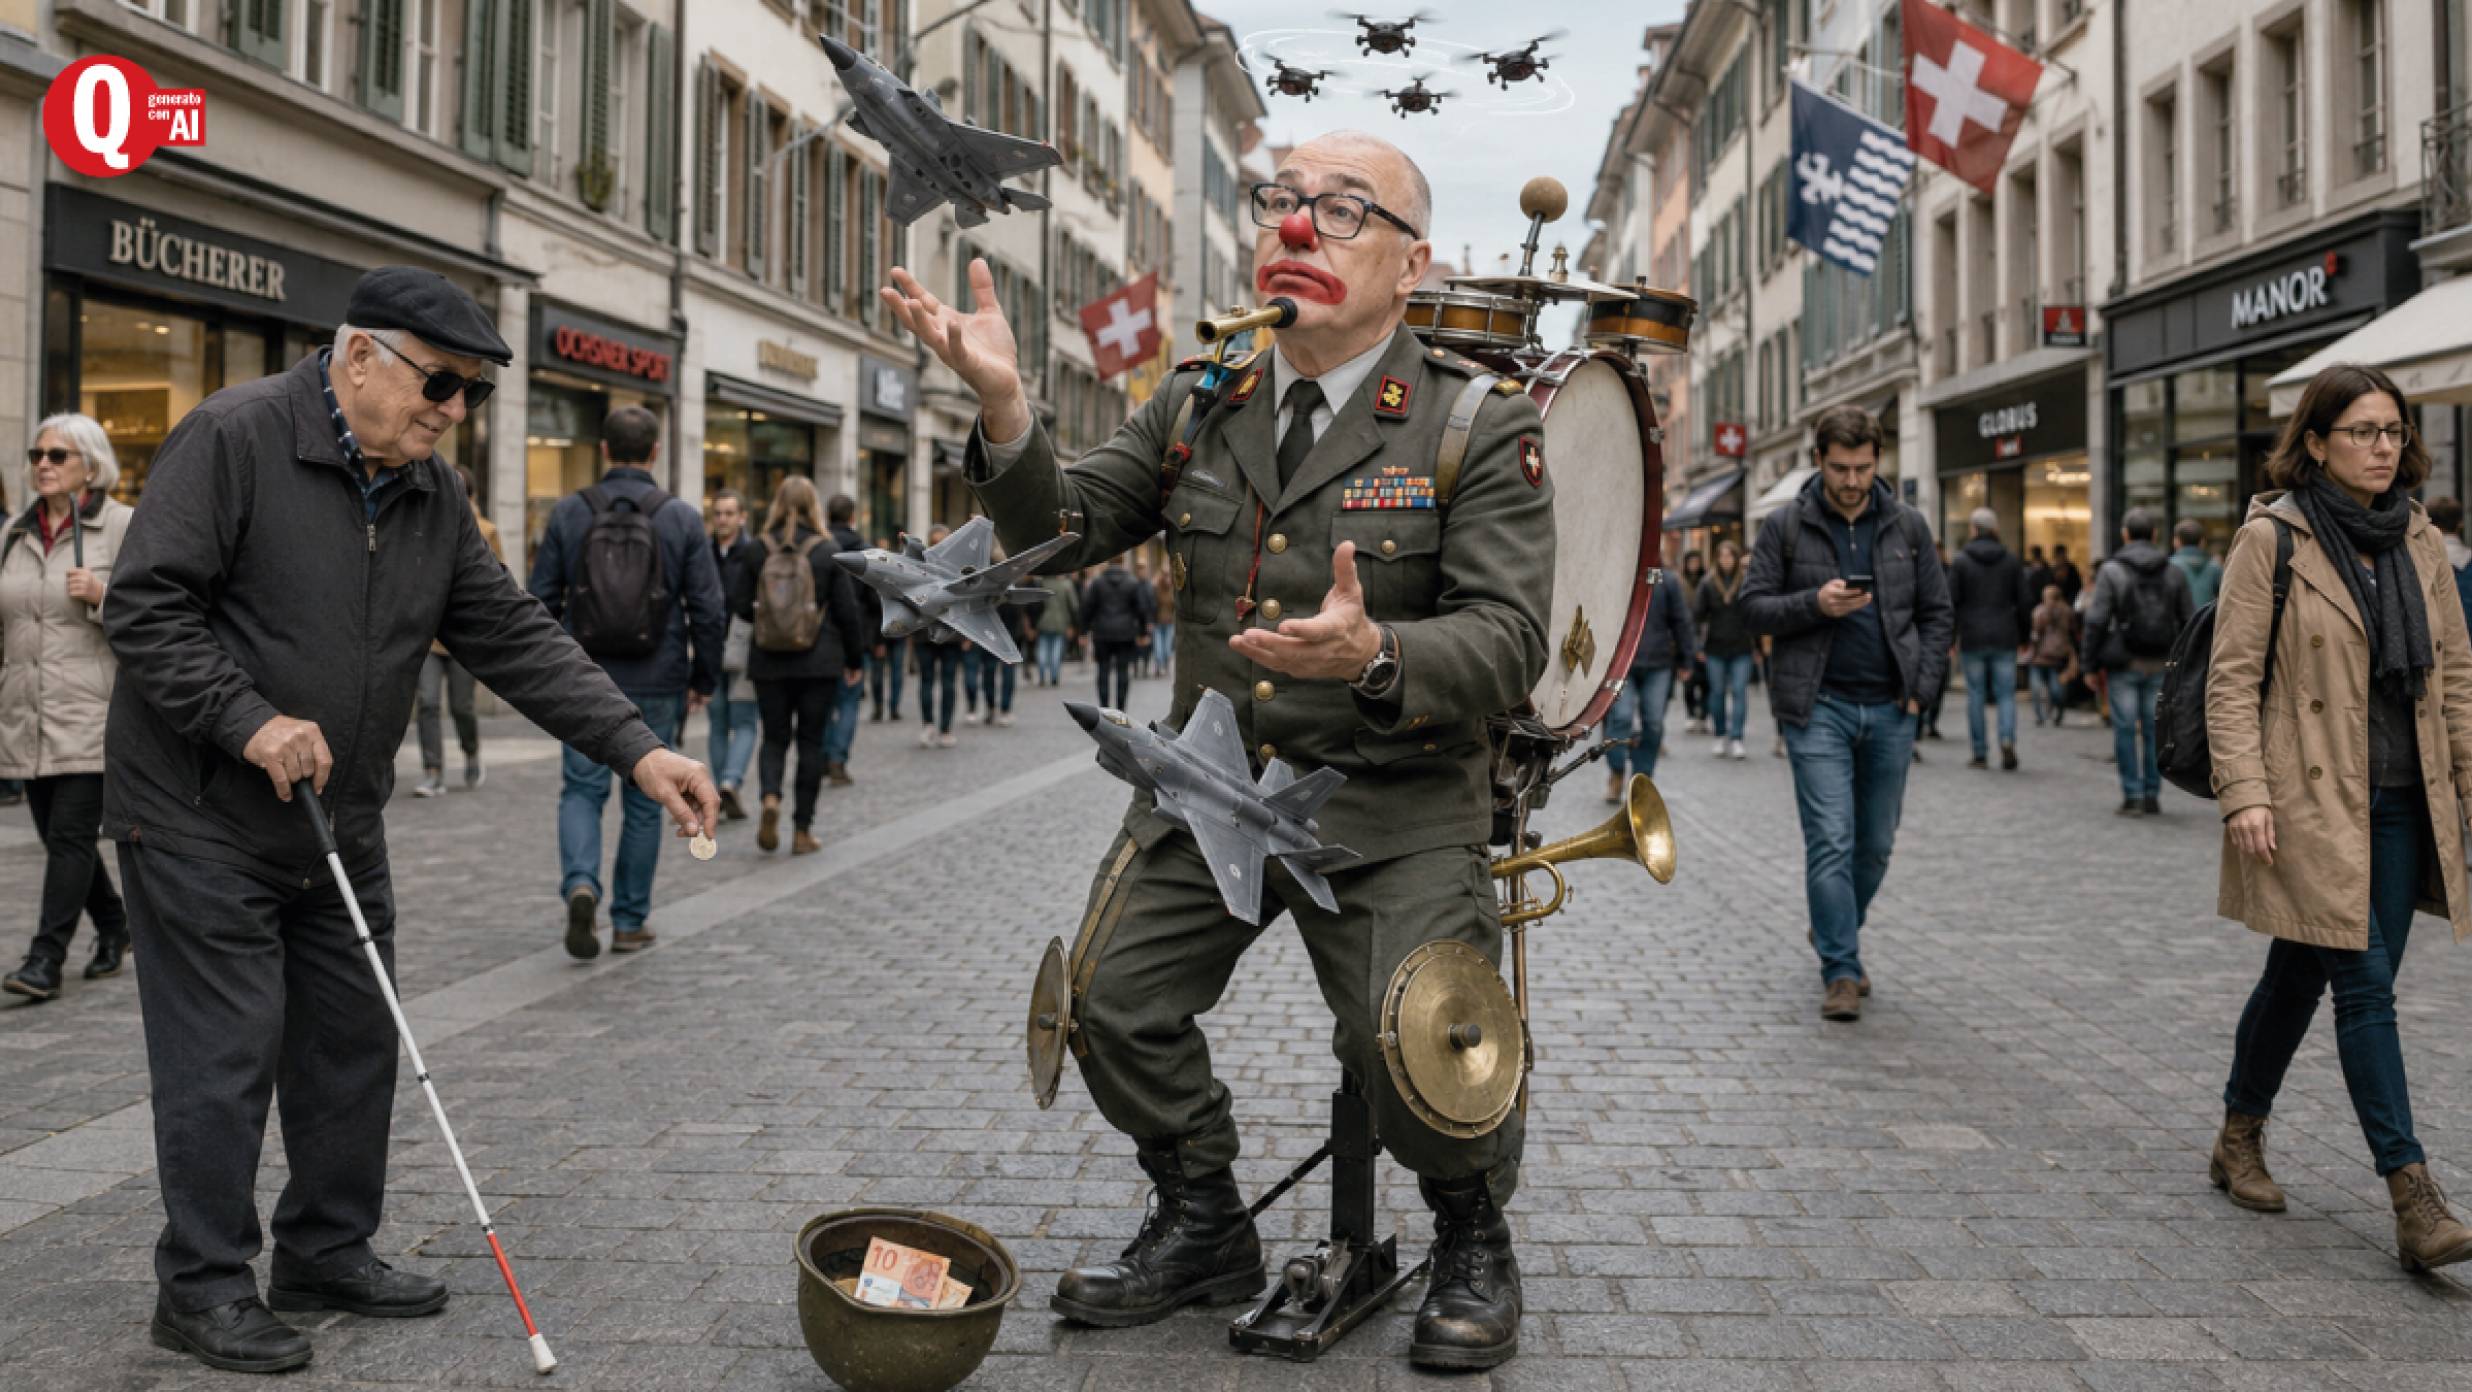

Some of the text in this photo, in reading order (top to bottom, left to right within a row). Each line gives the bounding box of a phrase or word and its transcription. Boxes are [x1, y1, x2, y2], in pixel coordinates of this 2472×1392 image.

[109, 216, 287, 301] BÜCHERER
[2232, 265, 2328, 329] MANOR
[556, 326, 628, 371] OCHSNER
[1979, 401, 2038, 438] GLOBUS
[872, 1245, 898, 1272] 10
